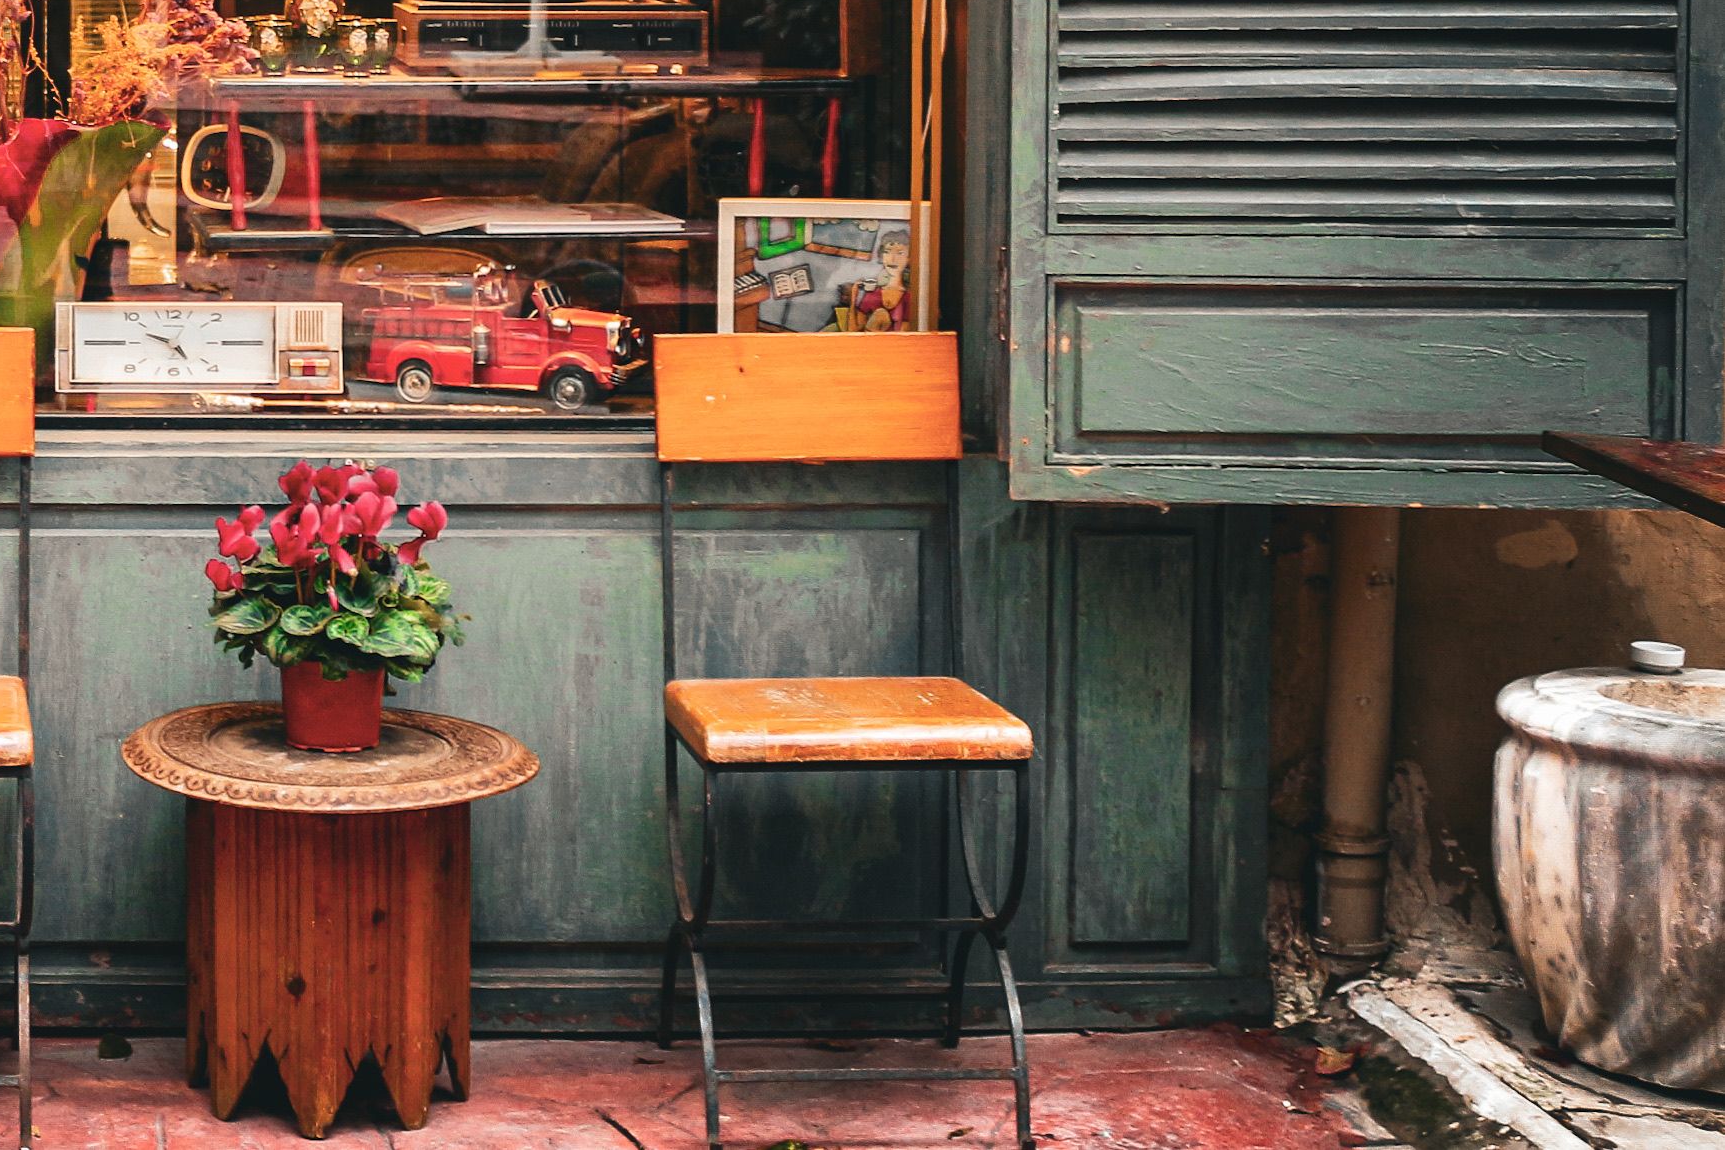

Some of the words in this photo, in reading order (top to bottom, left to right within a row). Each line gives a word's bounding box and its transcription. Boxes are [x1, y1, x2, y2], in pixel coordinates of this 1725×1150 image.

[123, 311, 140, 322] 10
[165, 309, 182, 319] 12
[210, 313, 222, 322] 2
[124, 364, 136, 374] 8
[167, 367, 180, 377] 6
[206, 364, 219, 373] 4
